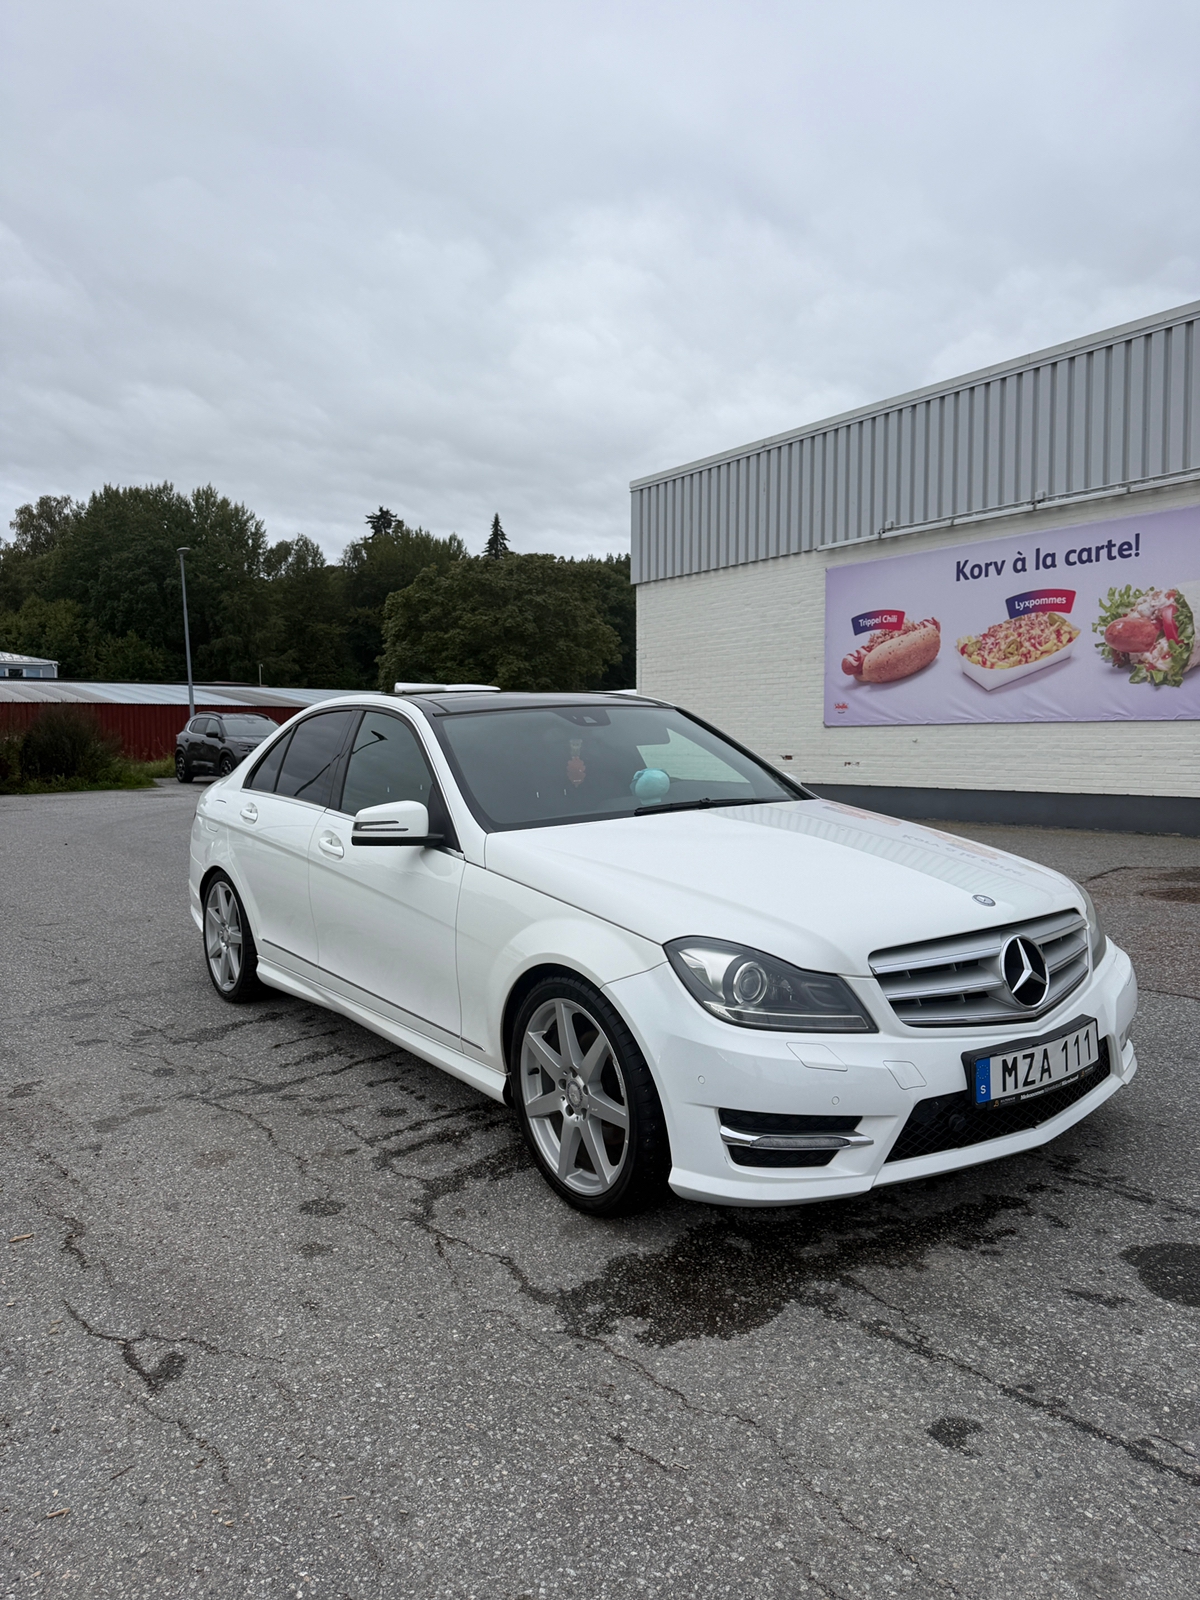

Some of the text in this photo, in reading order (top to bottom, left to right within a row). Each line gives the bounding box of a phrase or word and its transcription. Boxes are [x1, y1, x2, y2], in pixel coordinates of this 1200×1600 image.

[956, 533, 1141, 582] Korv à la carte!
[1015, 596, 1067, 611] Lyxpommes
[858, 614, 898, 627] Trippel Chili
[979, 1085, 987, 1095] S
[1001, 1048, 1052, 1092] MZA
[1061, 1028, 1091, 1072] 111
